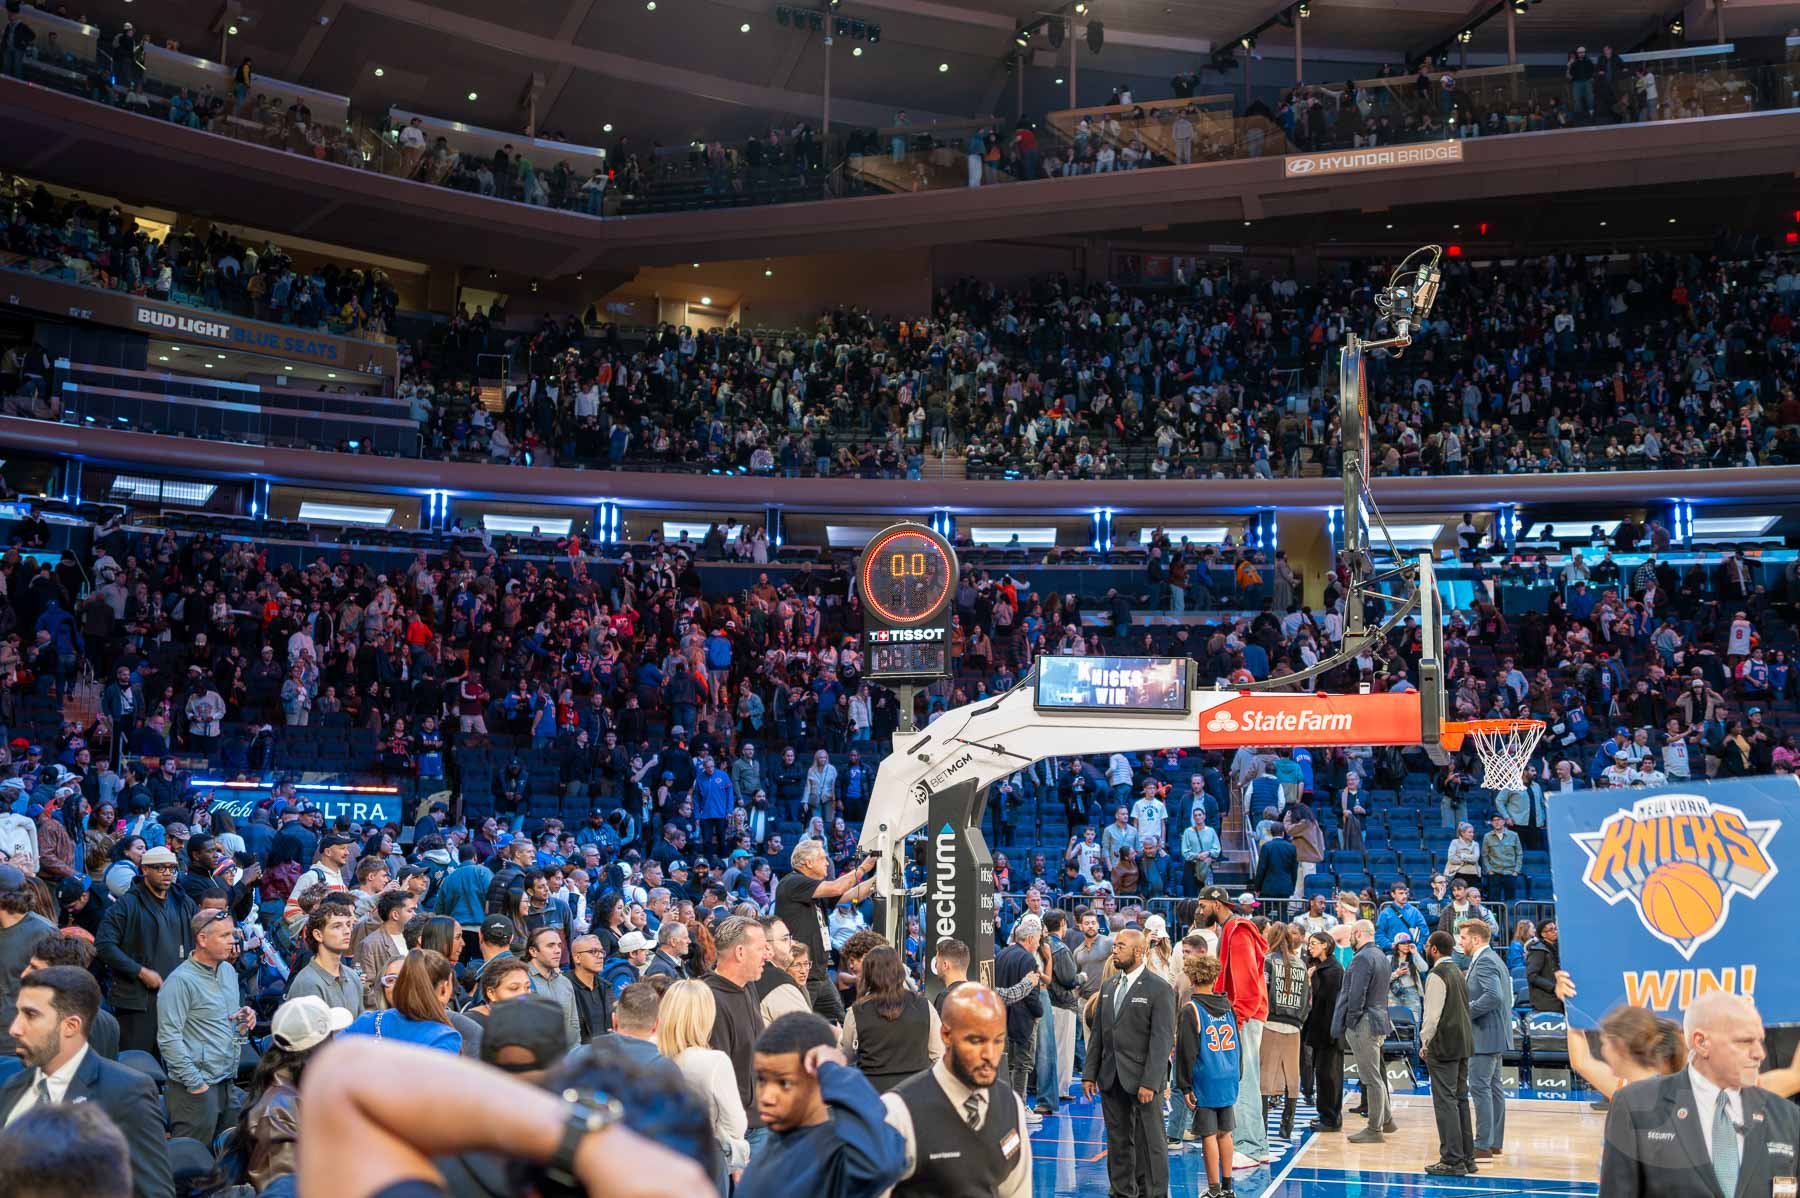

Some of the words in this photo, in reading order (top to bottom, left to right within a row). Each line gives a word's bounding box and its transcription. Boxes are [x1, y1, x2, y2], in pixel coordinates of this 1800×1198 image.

[1319, 152, 1394, 170] HYUNDAI
[1398, 146, 1458, 163] BRIDGE
[137, 308, 177, 328] BUD
[178, 315, 230, 339] LIGHT
[233, 326, 279, 347] BLUE
[284, 336, 338, 360] SEATS
[891, 553, 925, 577] 0.0
[890, 628, 945, 642] TISSOT
[1077, 661, 1143, 689] KNICKS
[1095, 688, 1129, 705] WIN
[930, 753, 973, 788] BETMGM
[1590, 811, 1771, 885] KNICKS
[931, 833, 956, 976] ectrum
[1206, 1024, 1236, 1051] 32
[1648, 1131, 1676, 1142] SECURITY
